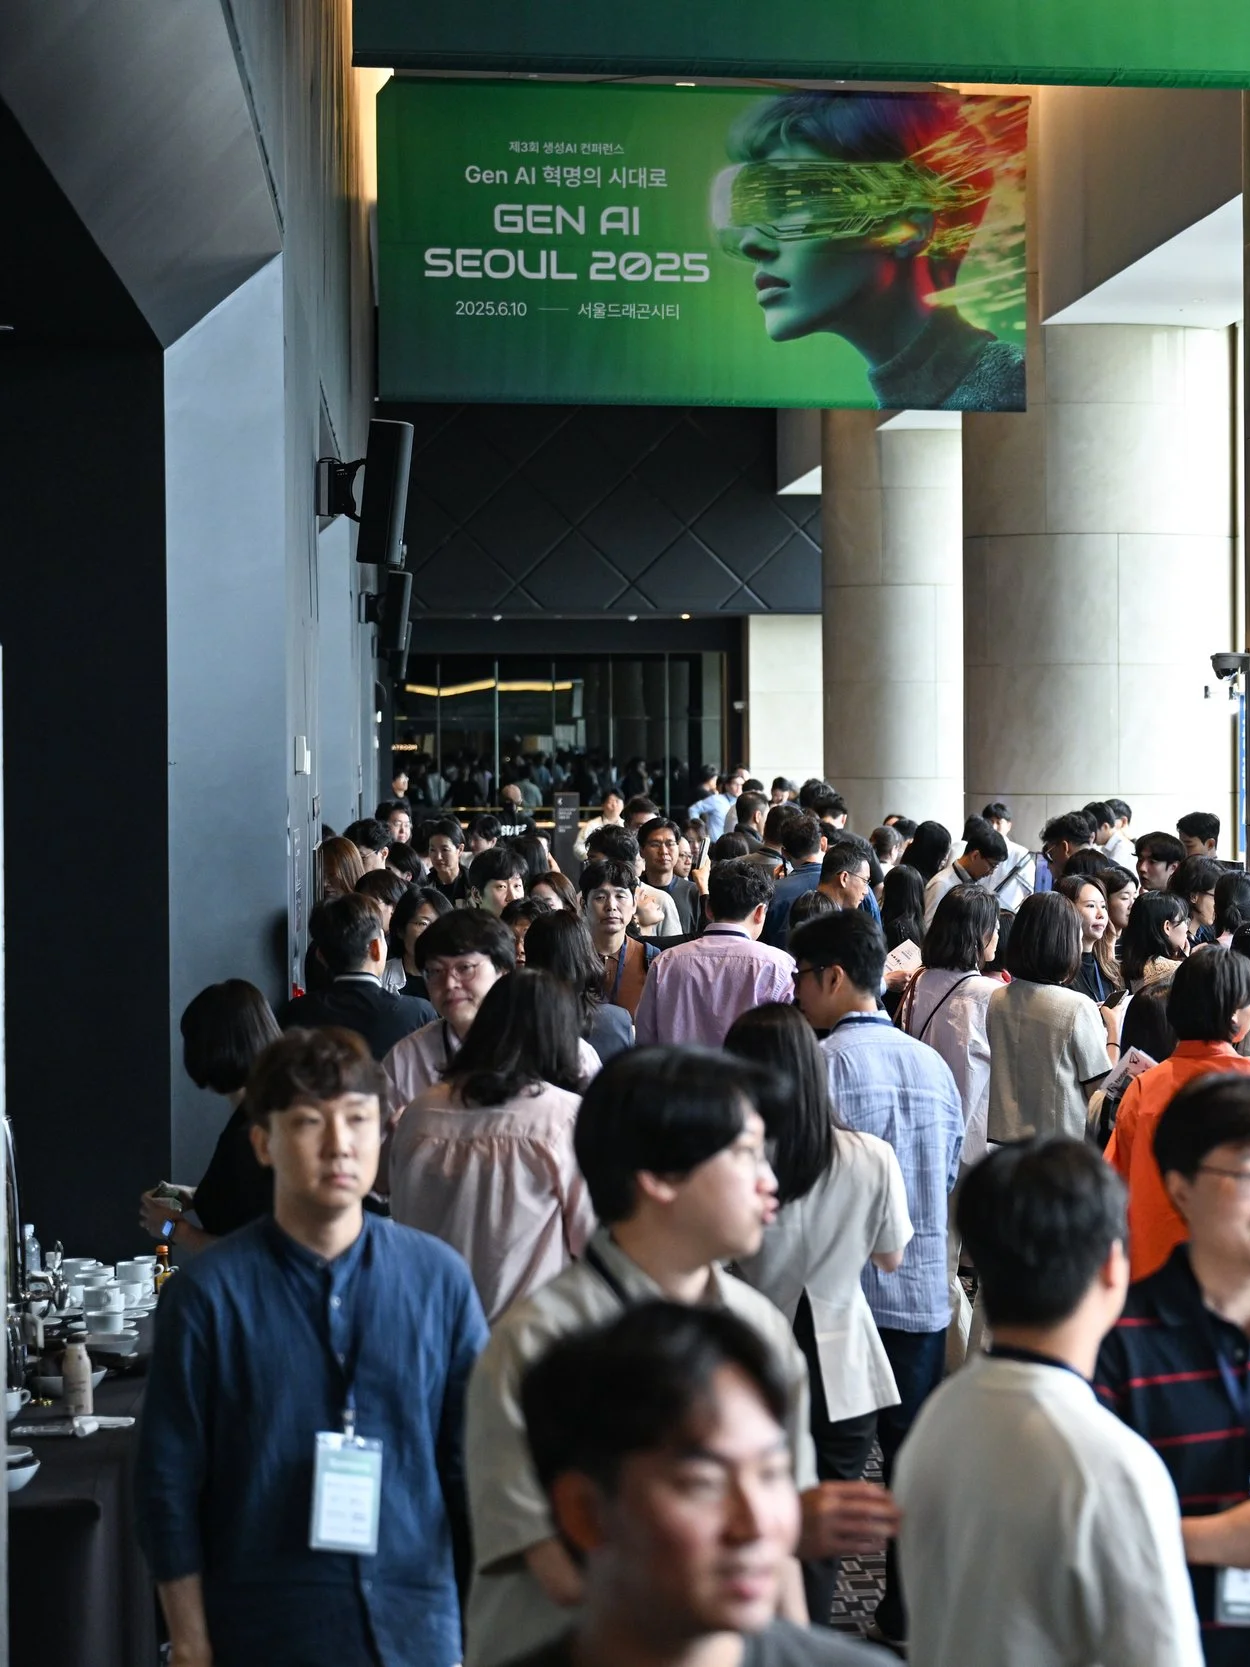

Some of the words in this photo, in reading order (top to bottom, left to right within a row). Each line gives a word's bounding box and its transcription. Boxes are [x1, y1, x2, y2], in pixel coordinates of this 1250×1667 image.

[509, 141, 539, 154] 제3회
[543, 142, 577, 155] 생성AI
[581, 143, 625, 156] 컨퍼런스
[465, 165, 508, 184] Gen
[514, 166, 536, 185] AI
[542, 165, 601, 188] 혁명의
[608, 167, 668, 189] 시대로
[494, 204, 586, 235] GEN
[600, 206, 640, 236] AI
[424, 248, 578, 280] SEOUL
[589, 251, 711, 283] 2025
[455, 300, 527, 317] 2025.6.10
[578, 302, 681, 320] 서울드래곤시티
